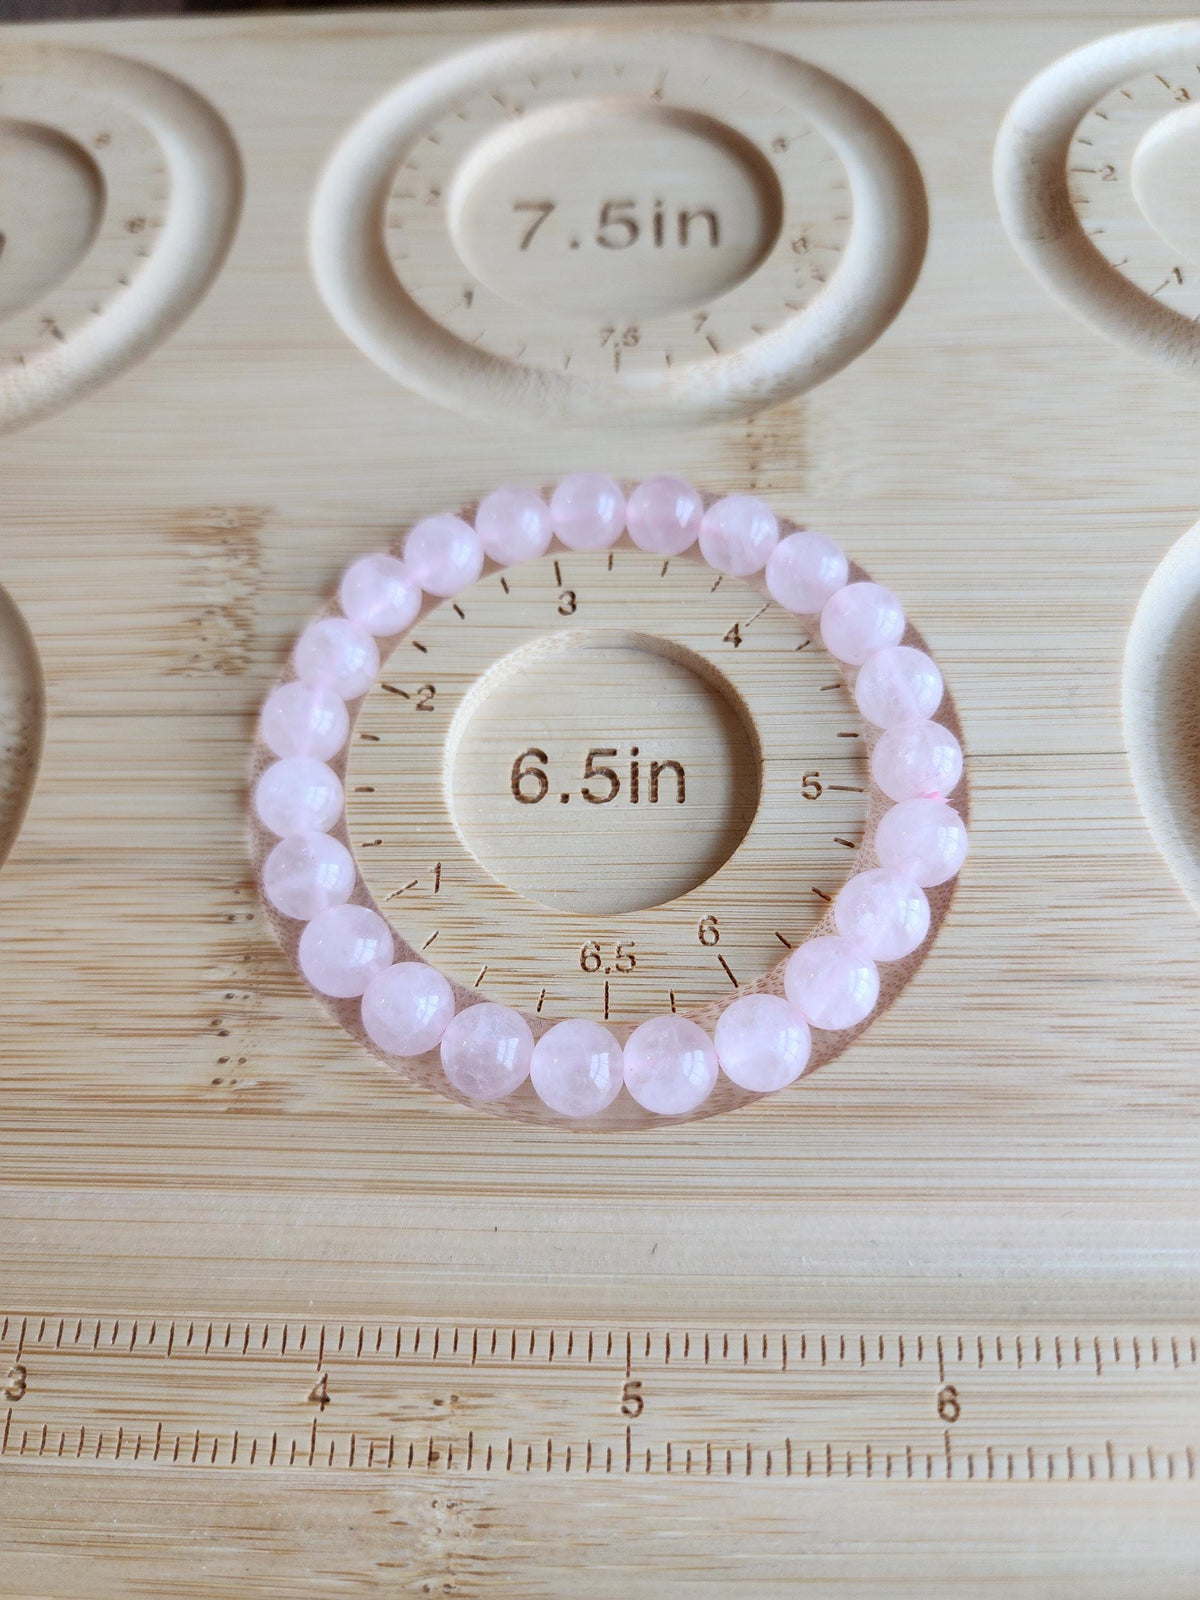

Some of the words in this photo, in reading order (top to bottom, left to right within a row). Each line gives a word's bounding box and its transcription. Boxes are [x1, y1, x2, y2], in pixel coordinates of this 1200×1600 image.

[1102, 164, 1118, 182] 2
[512, 198, 720, 251] 7.5in
[557, 590, 577, 616] 3
[723, 622, 743, 649] 4
[415, 684, 436, 711] 2
[510, 746, 687, 805] 6.5in
[801, 771, 823, 800] 5
[431, 862, 441, 893] 1
[700, 915, 720, 947] 6
[579, 941, 638, 974] 6.5
[5, 1365, 27, 1402] 3
[308, 1373, 331, 1412] 4
[621, 1381, 645, 1418] 5
[938, 1385, 961, 1423] 6
